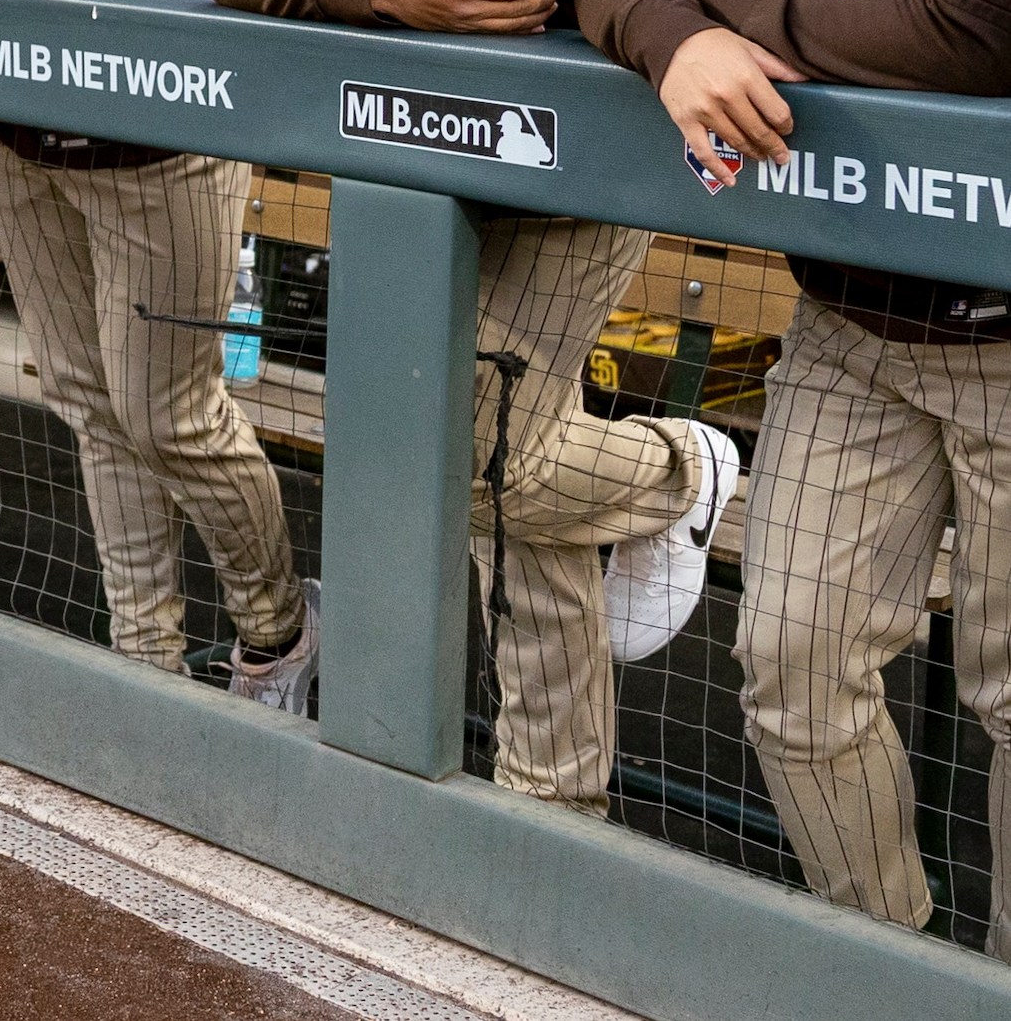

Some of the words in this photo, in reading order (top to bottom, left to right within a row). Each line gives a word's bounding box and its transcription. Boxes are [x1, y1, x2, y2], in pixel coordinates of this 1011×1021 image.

[61, 48, 234, 110] NETWORK
[346, 91, 491, 148] MLB.com
[757, 149, 867, 204] MLB
